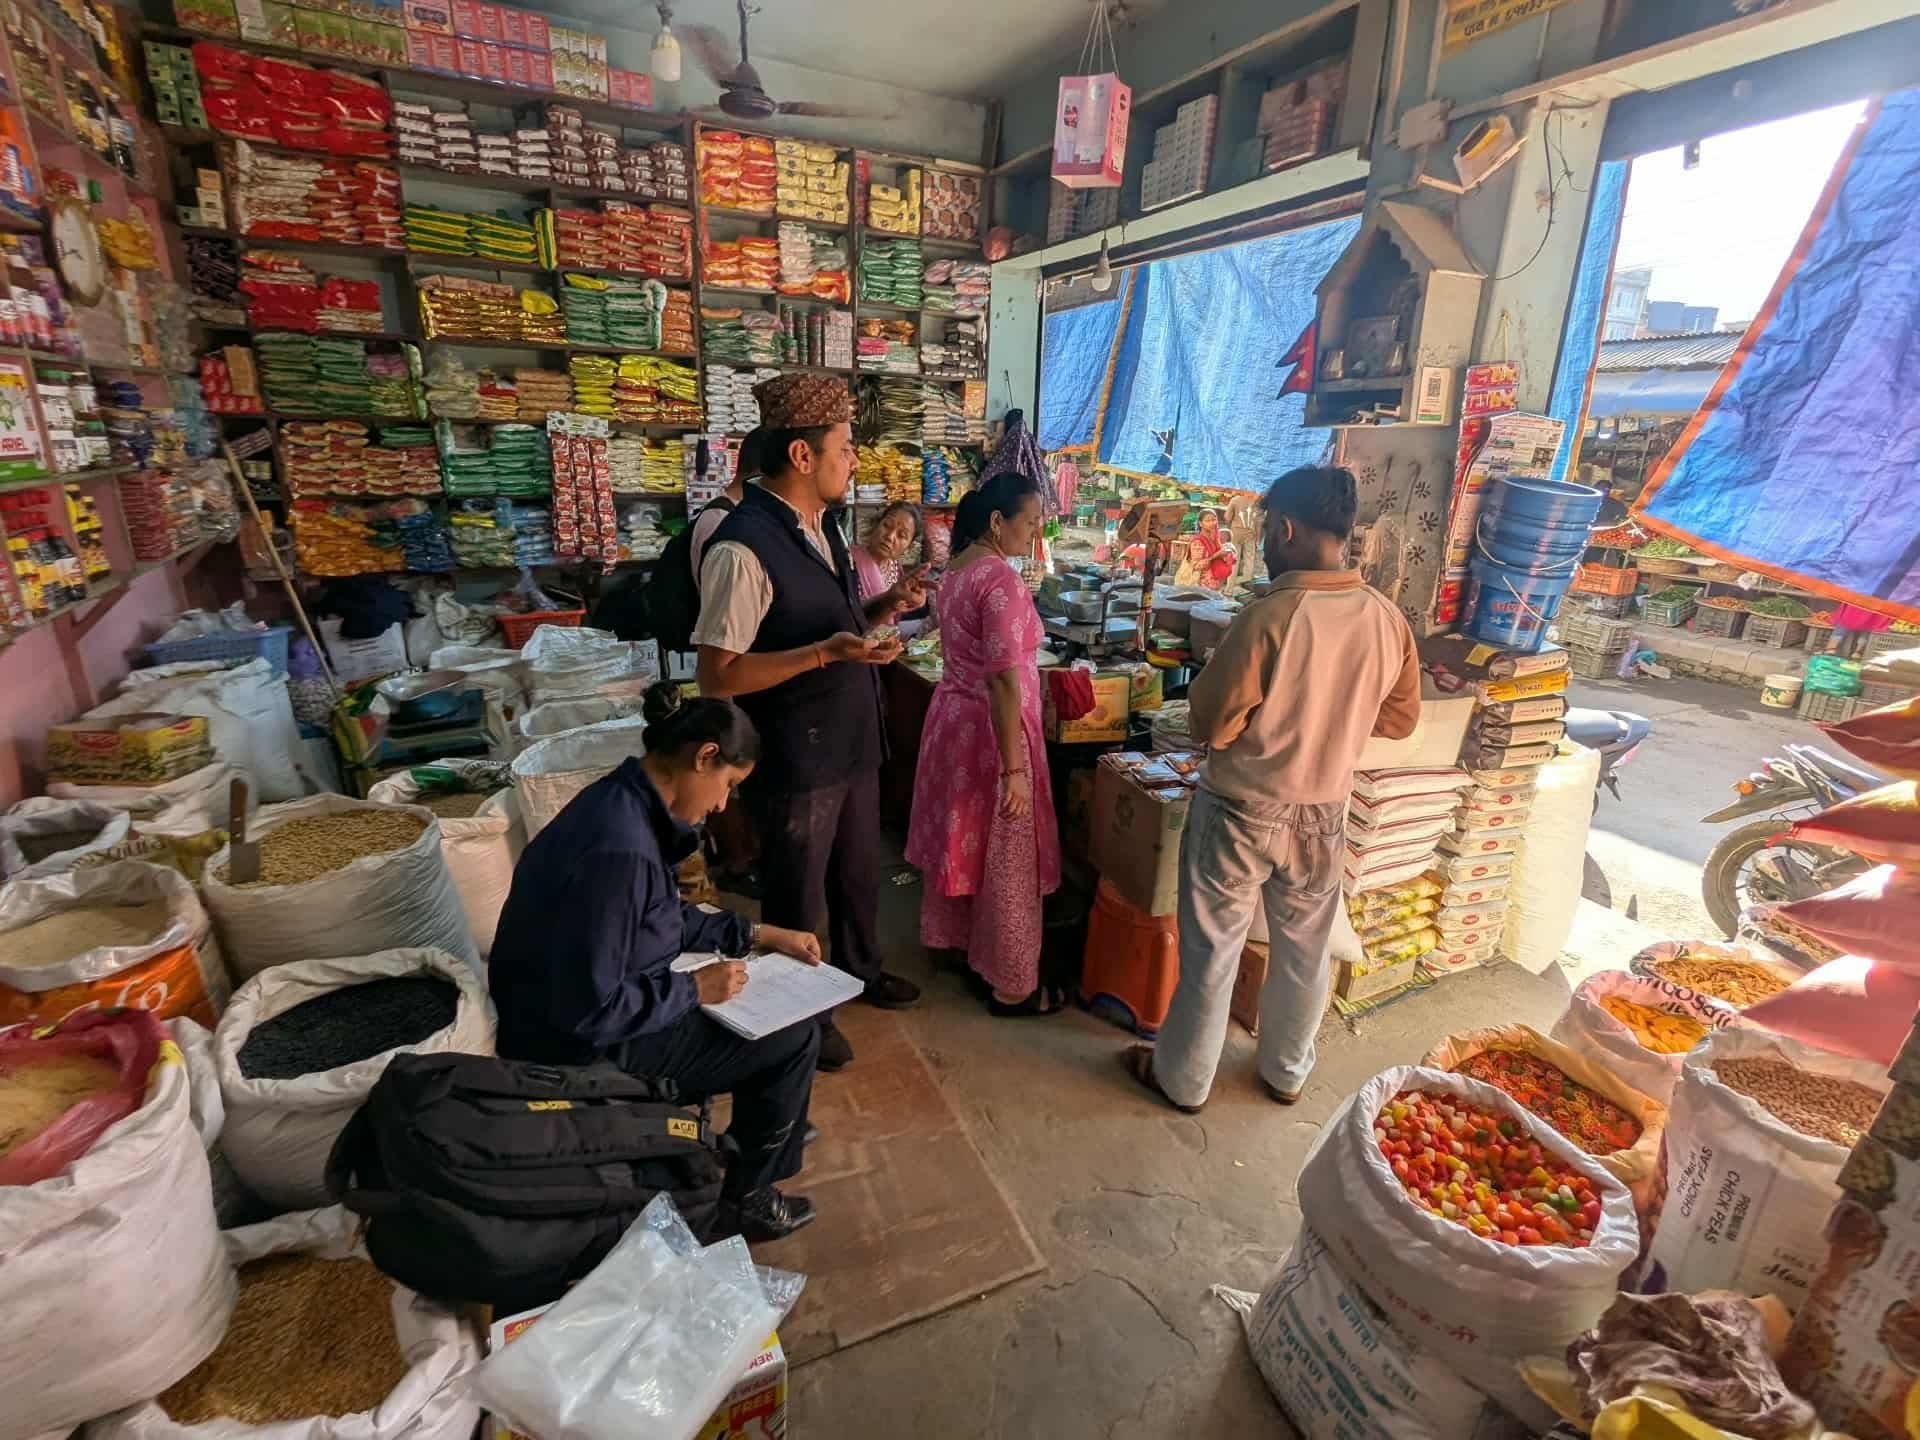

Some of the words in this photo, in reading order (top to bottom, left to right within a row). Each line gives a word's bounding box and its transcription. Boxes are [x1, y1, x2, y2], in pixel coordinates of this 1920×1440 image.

[1680, 1180, 1702, 1218] CHICK
[1698, 1146, 1713, 1182] PEAS
[1716, 1170, 1741, 1210] CHICK
[1704, 1209, 1727, 1244] PEAS
